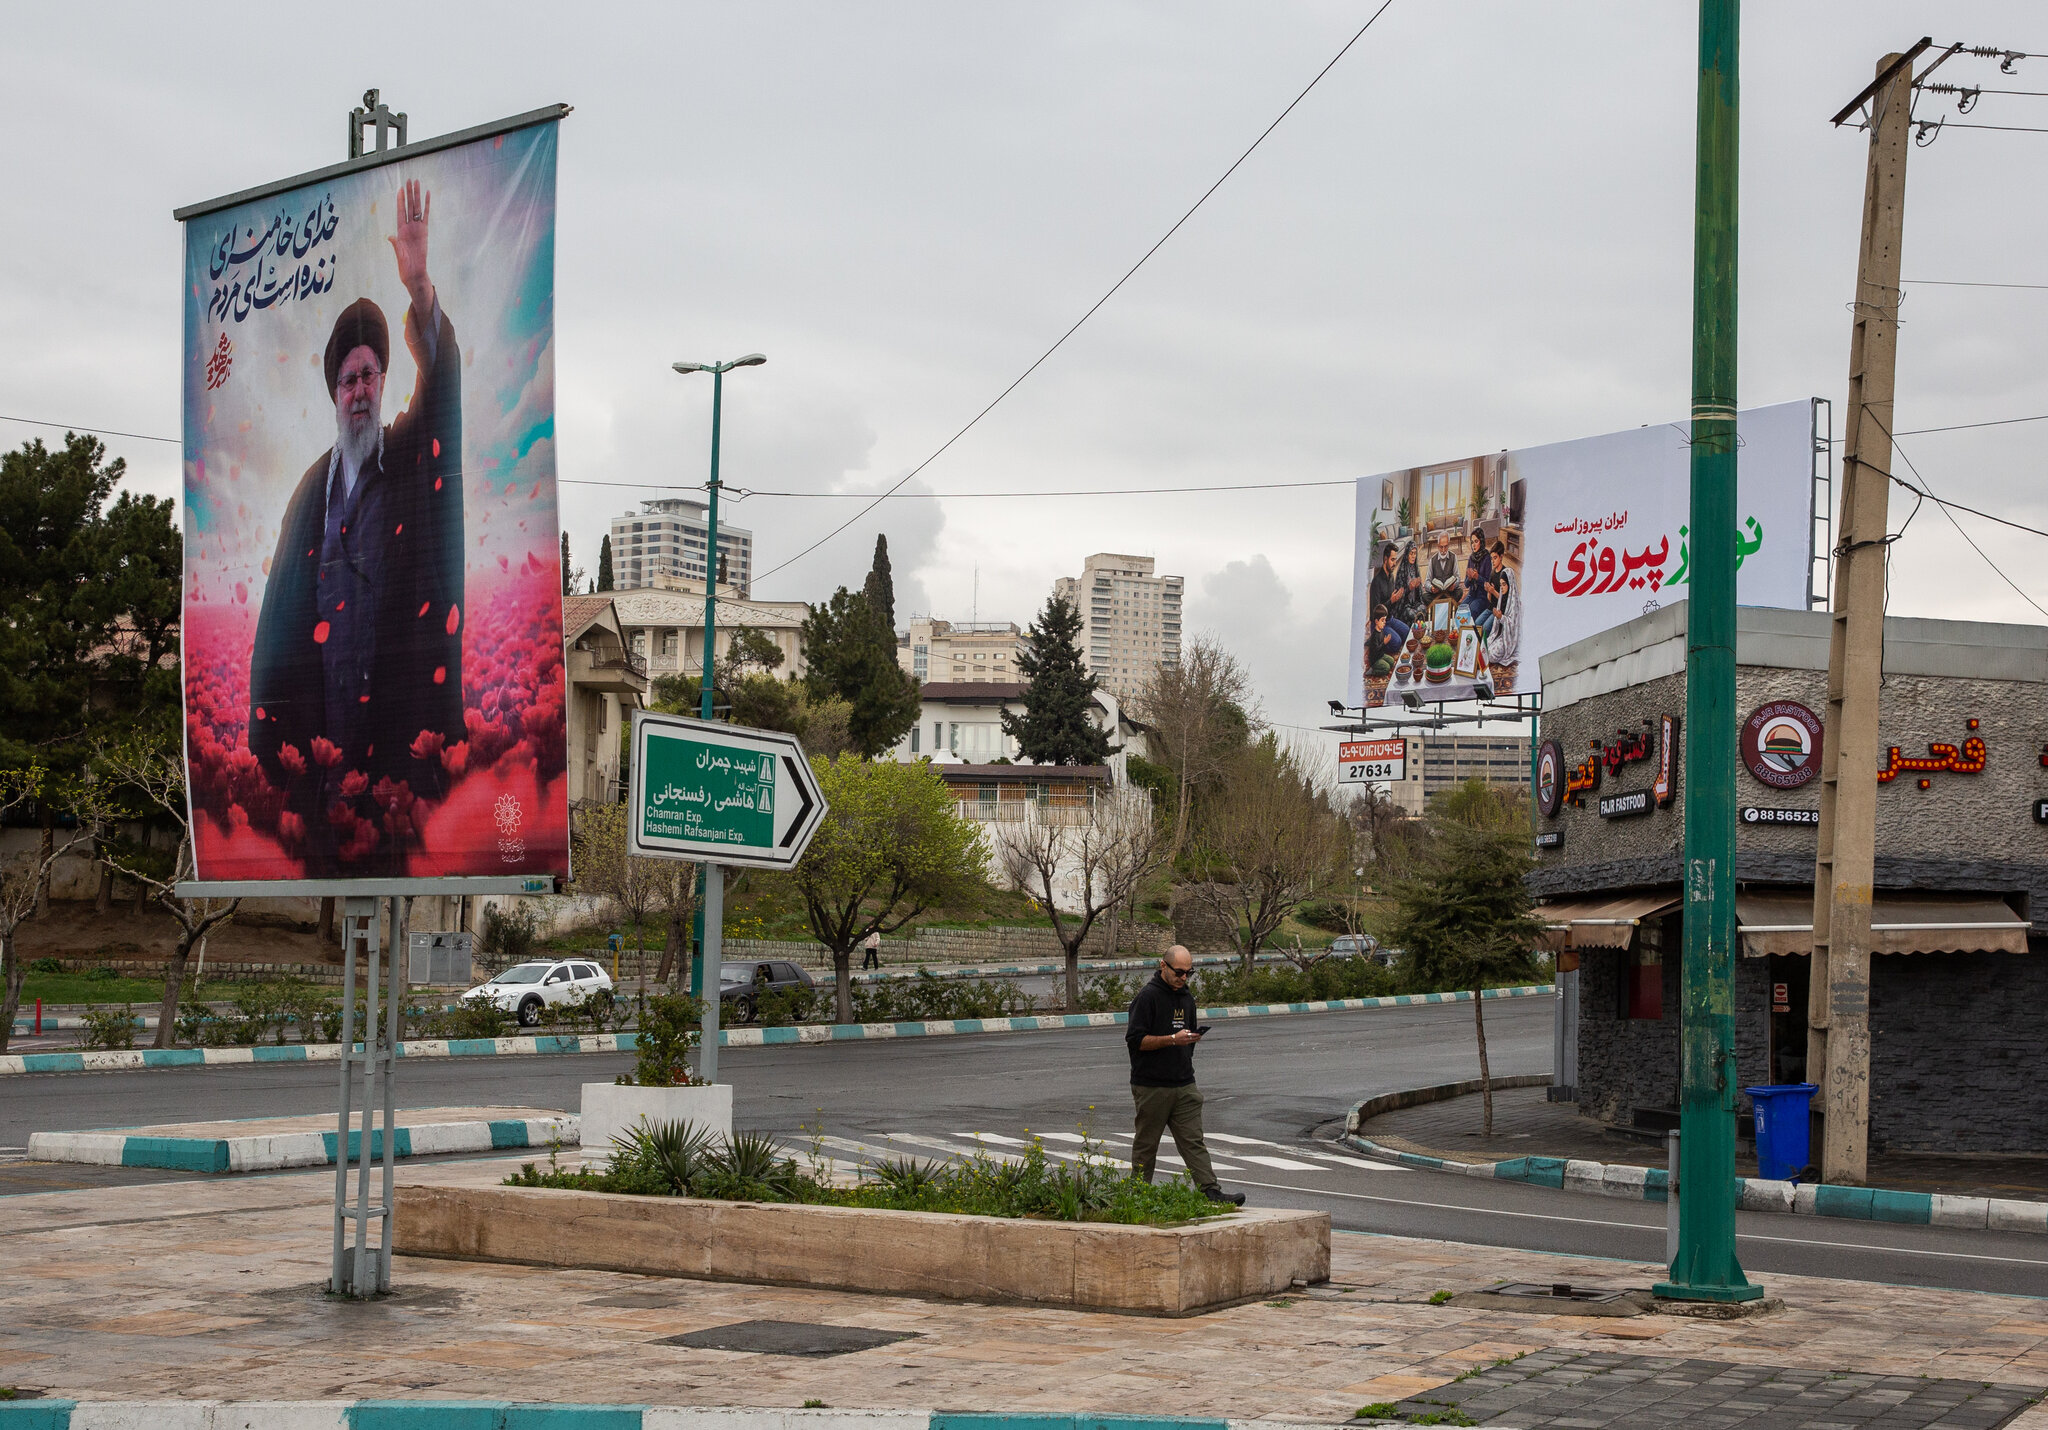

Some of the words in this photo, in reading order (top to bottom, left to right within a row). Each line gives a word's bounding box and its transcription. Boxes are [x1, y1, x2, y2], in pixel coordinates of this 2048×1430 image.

[1605, 510, 1628, 530] ایران
[1552, 534, 1669, 597] پیروزی
[1752, 708, 1774, 729] FAJR
[1775, 705, 1820, 734] FASTFOOD
[696, 749, 731, 775] چمران
[1877, 718, 1986, 789] فجر
[733, 760, 756, 775] شهید
[1350, 764, 1392, 778] 27634
[1754, 764, 1812, 785] 88565288
[653, 783, 712, 807] رفسنجانی
[746, 783, 758, 794] آیت
[714, 790, 755, 812] هاشمی
[1600, 800, 1616, 815] FAJR
[1616, 793, 1646, 812] FASTFOOD
[646, 806, 684, 821] Chamran
[686, 810, 704, 825] Exp.
[646, 820, 683, 835] Hashemi
[684, 824, 727, 841] Rafsanjani
[728, 829, 745, 844] Exp.
